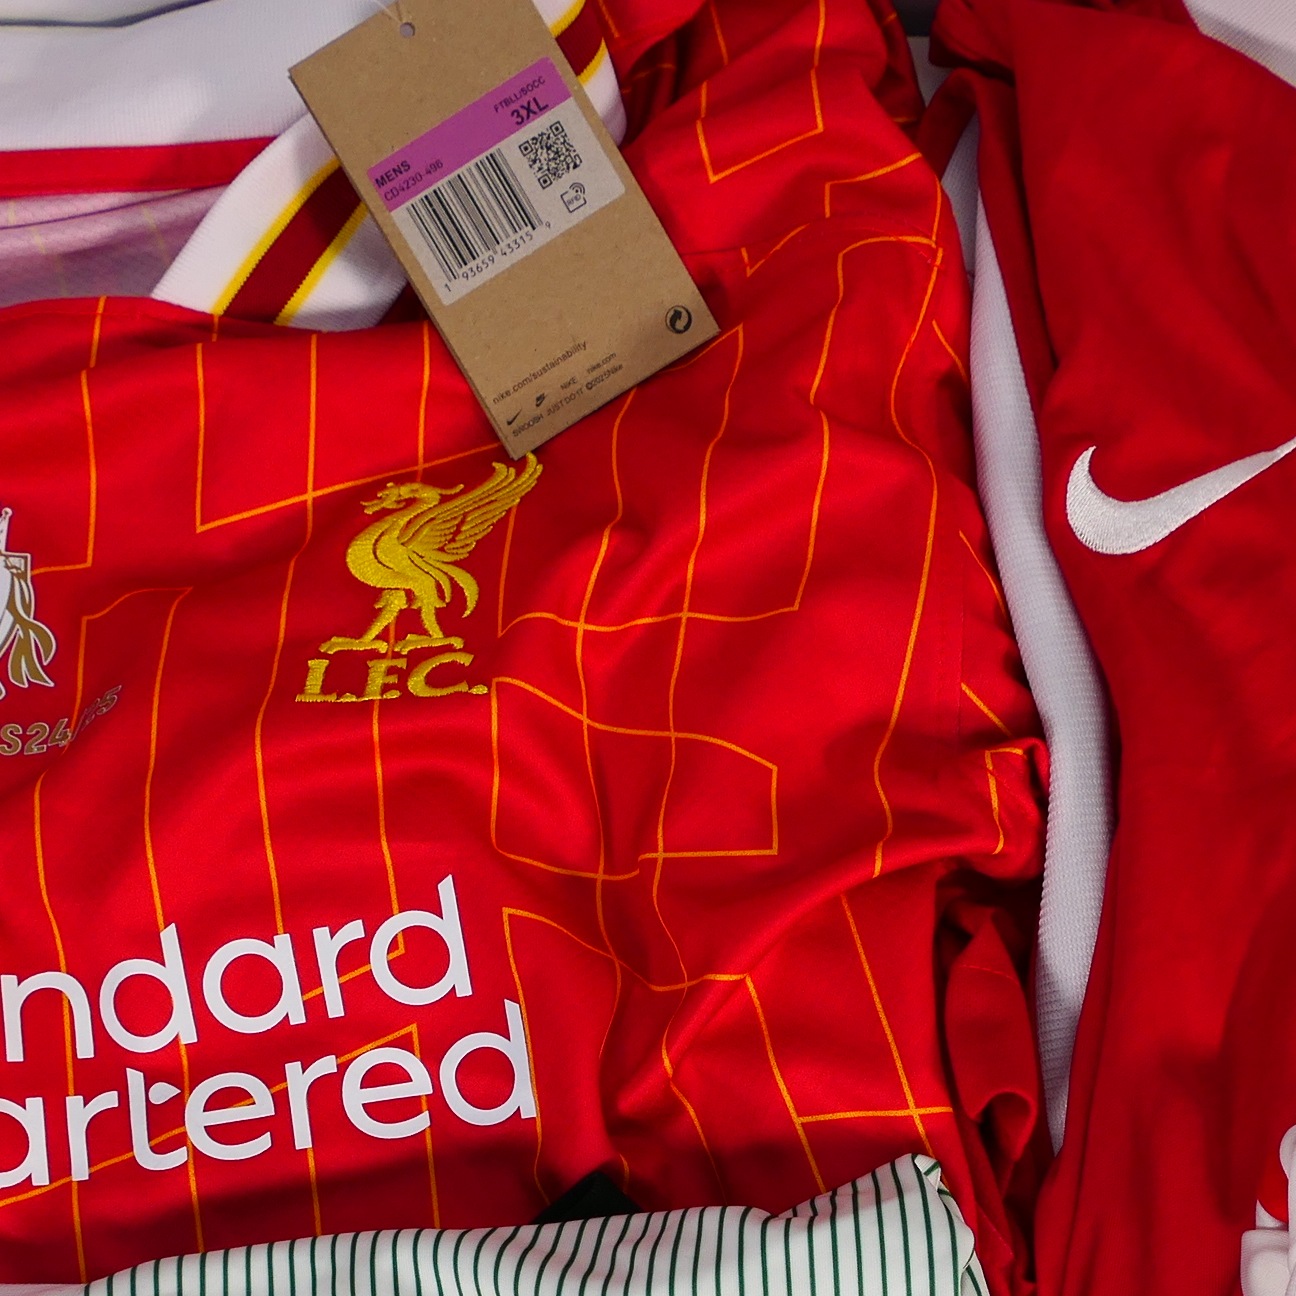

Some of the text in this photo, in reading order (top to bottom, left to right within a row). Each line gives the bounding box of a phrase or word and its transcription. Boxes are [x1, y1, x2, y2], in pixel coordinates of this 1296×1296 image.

[510, 97, 549, 126] 3XL
[375, 160, 411, 188] MENS
[444, 283, 451, 292] 1
[462, 256, 495, 281] 93659
[492, 341, 587, 404] nike.com/sustainability
[560, 376, 578, 390] NIKE
[295, 651, 489, 704] L.F.C.
